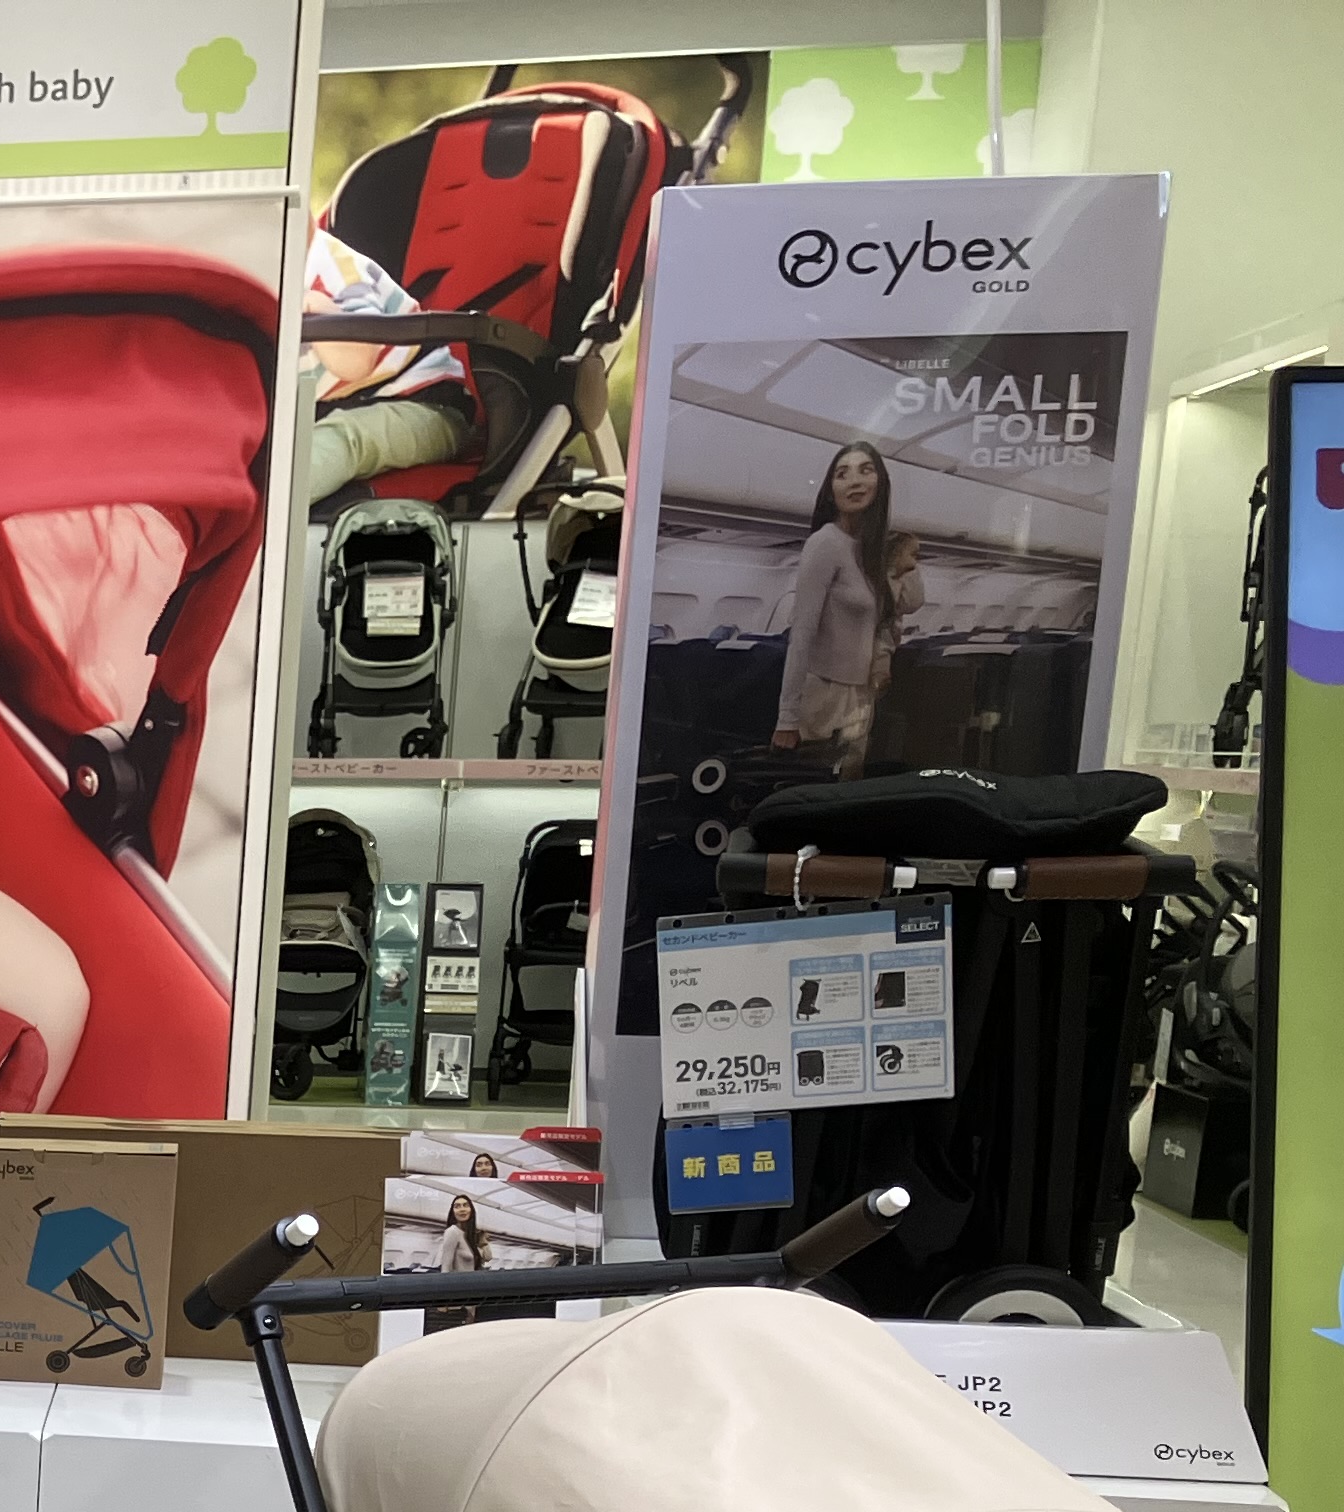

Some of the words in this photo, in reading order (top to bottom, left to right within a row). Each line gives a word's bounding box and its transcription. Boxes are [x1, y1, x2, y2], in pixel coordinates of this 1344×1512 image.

[29, 69, 114, 109] baby
[845, 220, 1034, 296] cybex
[972, 279, 1030, 294] GOLD
[893, 373, 1098, 416] SMALL
[971, 413, 1096, 445] FOLD
[970, 445, 1092, 468] GENIUS
[900, 921, 940, 933] SELECT
[669, 977, 698, 987] リベル
[675, 1054, 781, 1083] 29,250円
[682, 1150, 776, 1179] 新商品
[958, 1375, 1003, 1392] JP2
[1175, 1444, 1235, 1464] cybex
